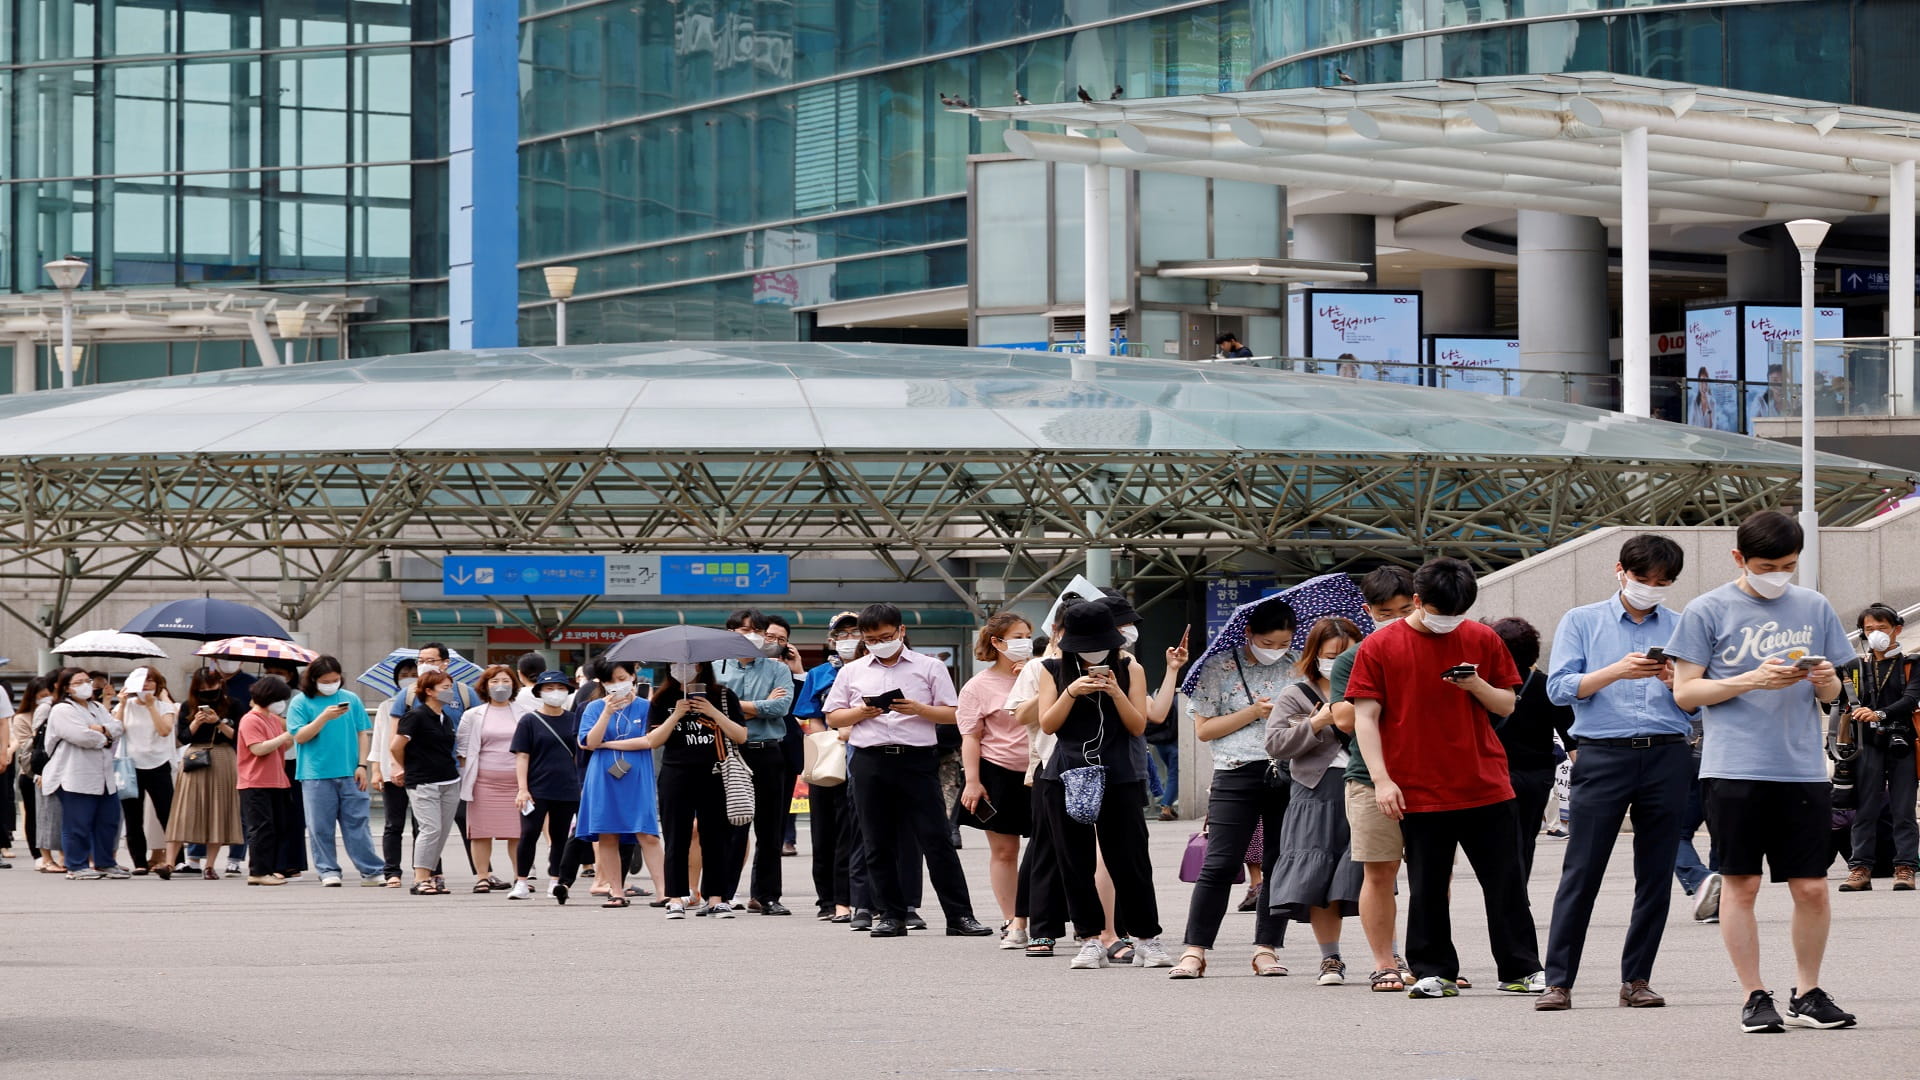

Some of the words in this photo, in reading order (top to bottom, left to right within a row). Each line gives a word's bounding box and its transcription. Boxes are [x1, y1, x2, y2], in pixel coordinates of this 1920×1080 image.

[1319, 305, 1345, 318] 나는
[1331, 316, 1386, 341] 덕성이다
[1751, 317, 1774, 330] 나는
[1669, 335, 1686, 349] LO
[1441, 349, 1464, 360] 나는
[1217, 589, 1238, 600] 광장
[565, 631, 598, 640] 초코파이
[600, 631, 625, 640] 하우스
[1721, 621, 1813, 666] Hawaii
